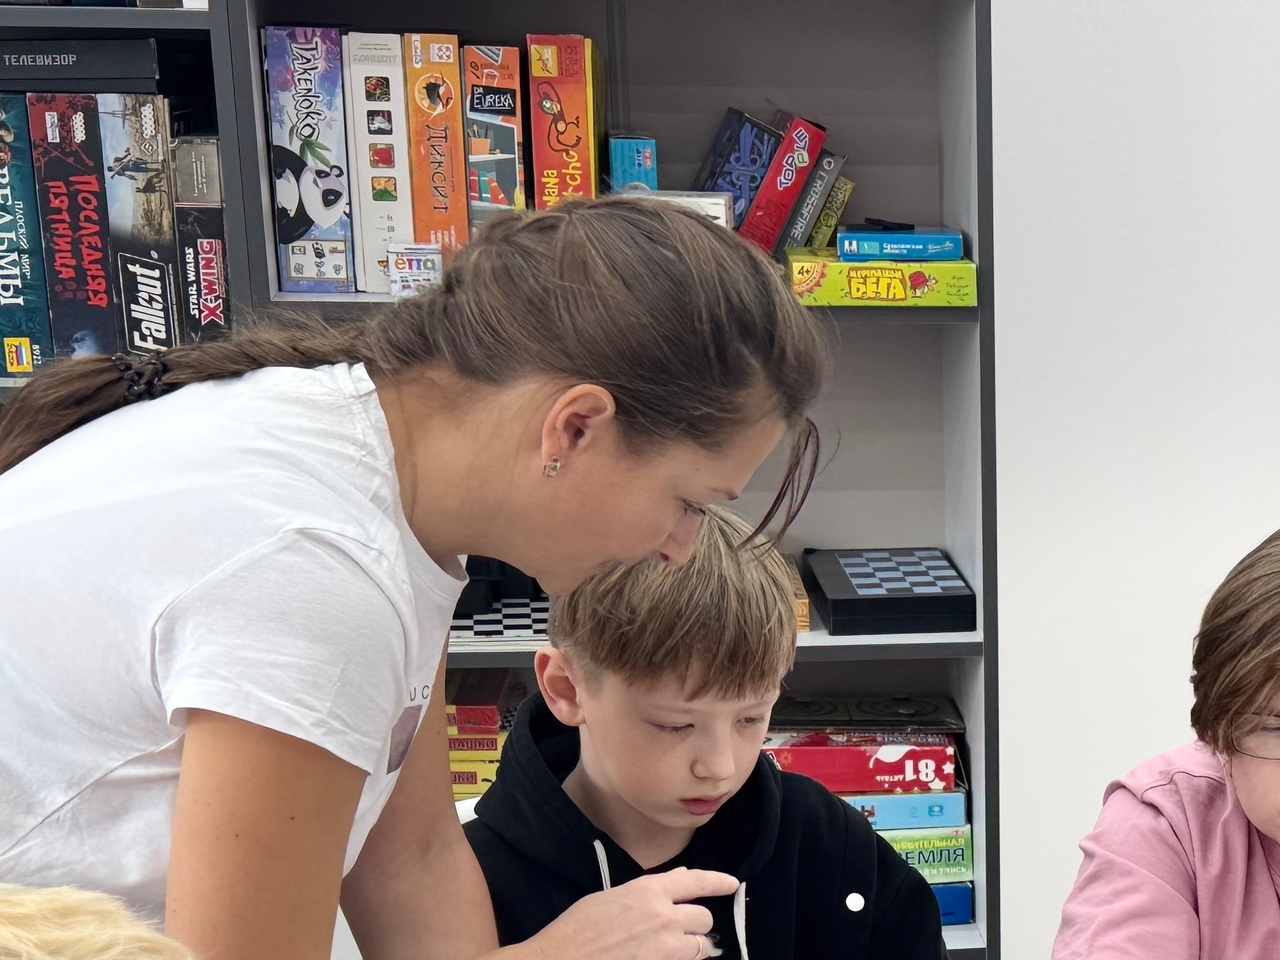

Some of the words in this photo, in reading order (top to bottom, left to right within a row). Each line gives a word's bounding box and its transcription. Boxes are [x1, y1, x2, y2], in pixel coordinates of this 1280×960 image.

[3, 54, 77, 66] ТЕЛЕВИЗОР
[289, 36, 327, 142] TAKENOKO
[474, 93, 515, 108] EUREKA
[43, 181, 78, 279] ПЯТНИЦА
[69, 173, 109, 308] ПОСЛЕДНЯЯ
[185, 246, 195, 282] WARS
[197, 239, 224, 326] X-WING
[850, 278, 907, 299] БЕГА
[127, 262, 168, 350] Fallout
[189, 283, 199, 319] STAR
[904, 759, 936, 782] 81
[898, 848, 965, 866] ЕМЛЯ
